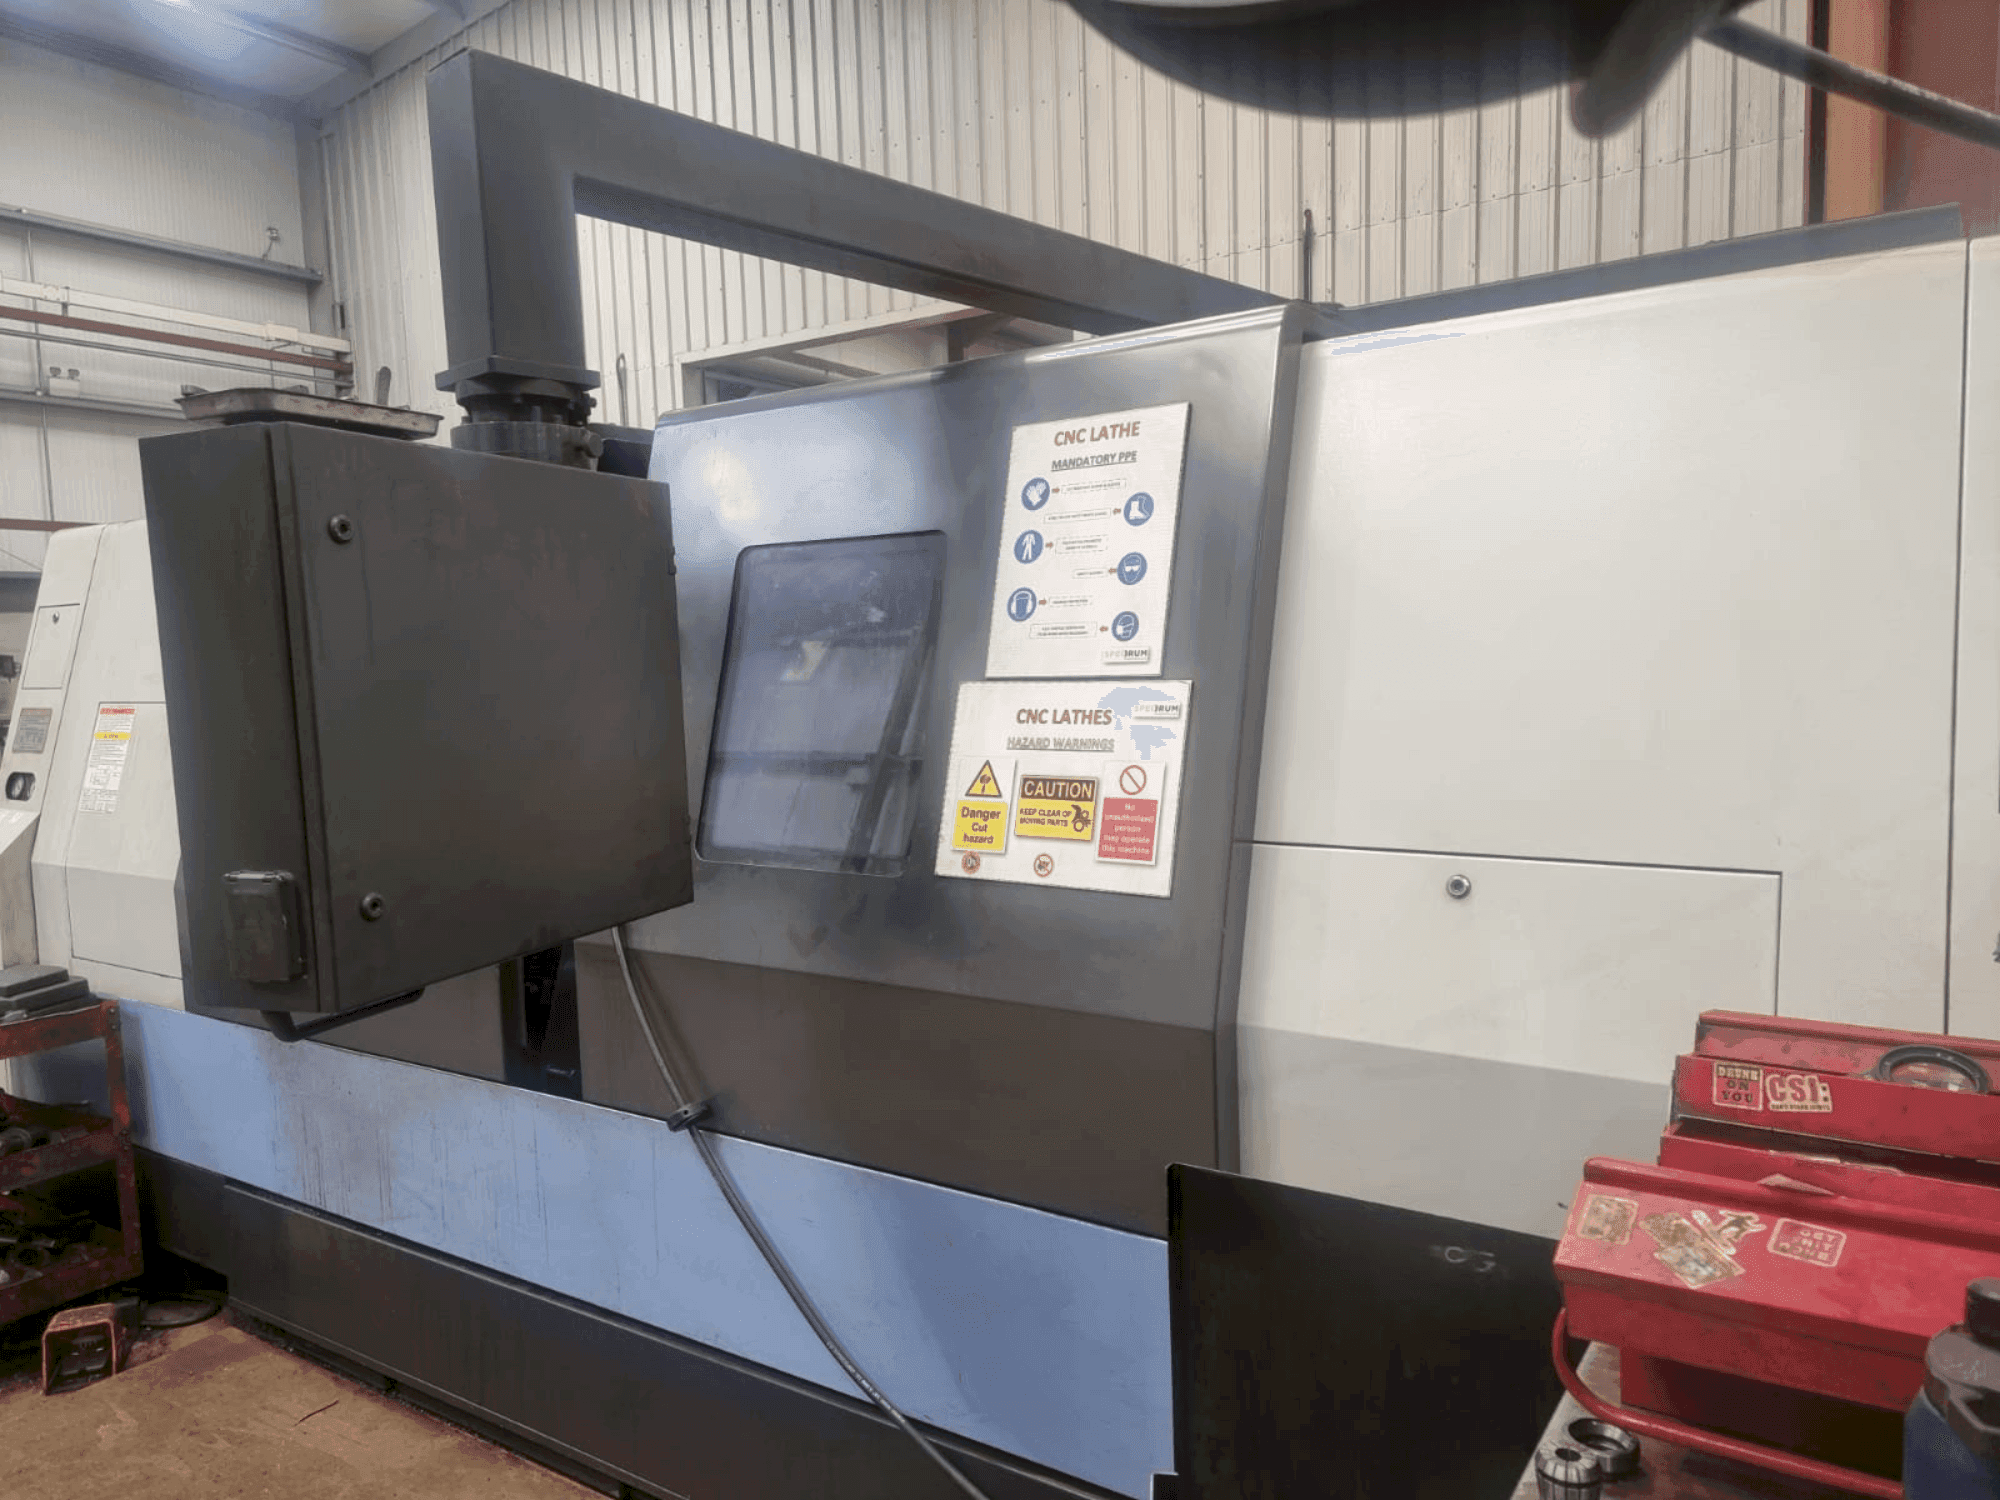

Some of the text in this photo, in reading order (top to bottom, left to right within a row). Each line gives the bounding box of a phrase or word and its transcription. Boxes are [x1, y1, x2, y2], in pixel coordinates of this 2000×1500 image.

[1054, 421, 1141, 446] CNC LATHE
[1051, 450, 1138, 471] MANDATORY PPE
[1016, 708, 1113, 726] CNC LATHES
[1006, 736, 1115, 751] HAZARD WARNINGS
[1024, 780, 1093, 799] CAUTION
[961, 806, 1002, 823] Danger
[971, 822, 988, 834] Cut
[962, 833, 995, 845] hazard
